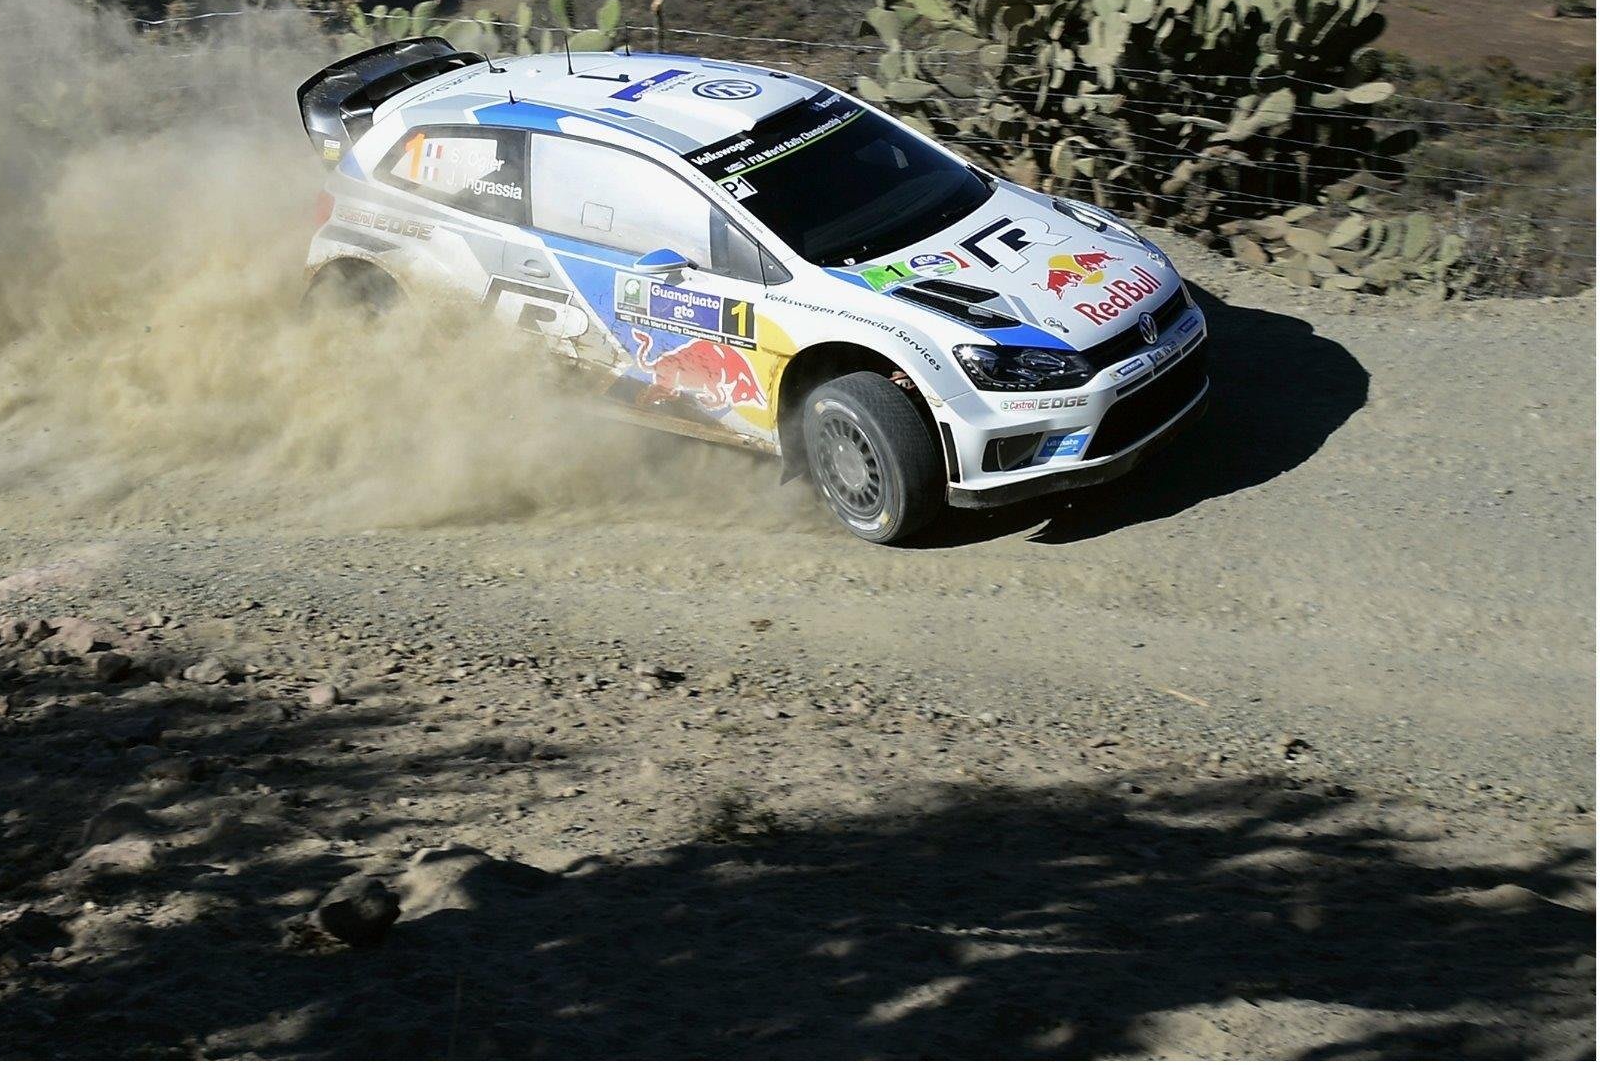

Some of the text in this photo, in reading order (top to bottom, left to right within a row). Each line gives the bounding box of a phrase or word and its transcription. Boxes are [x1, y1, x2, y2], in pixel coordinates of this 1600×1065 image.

[404, 133, 426, 180] 1
[690, 138, 756, 166] Volkswagen
[747, 153, 766, 165] FIA
[761, 143, 787, 158] World
[462, 172, 523, 200] Ingrassia
[721, 176, 756, 200] P1
[373, 214, 436, 241] EDGE
[885, 264, 905, 277] 1
[651, 285, 720, 310] Guanajuato
[673, 305, 695, 319] gto
[731, 300, 748, 337] 1
[764, 292, 942, 371] Volkswagen Financial Services
[1009, 395, 1089, 410] Castrol EDGE
